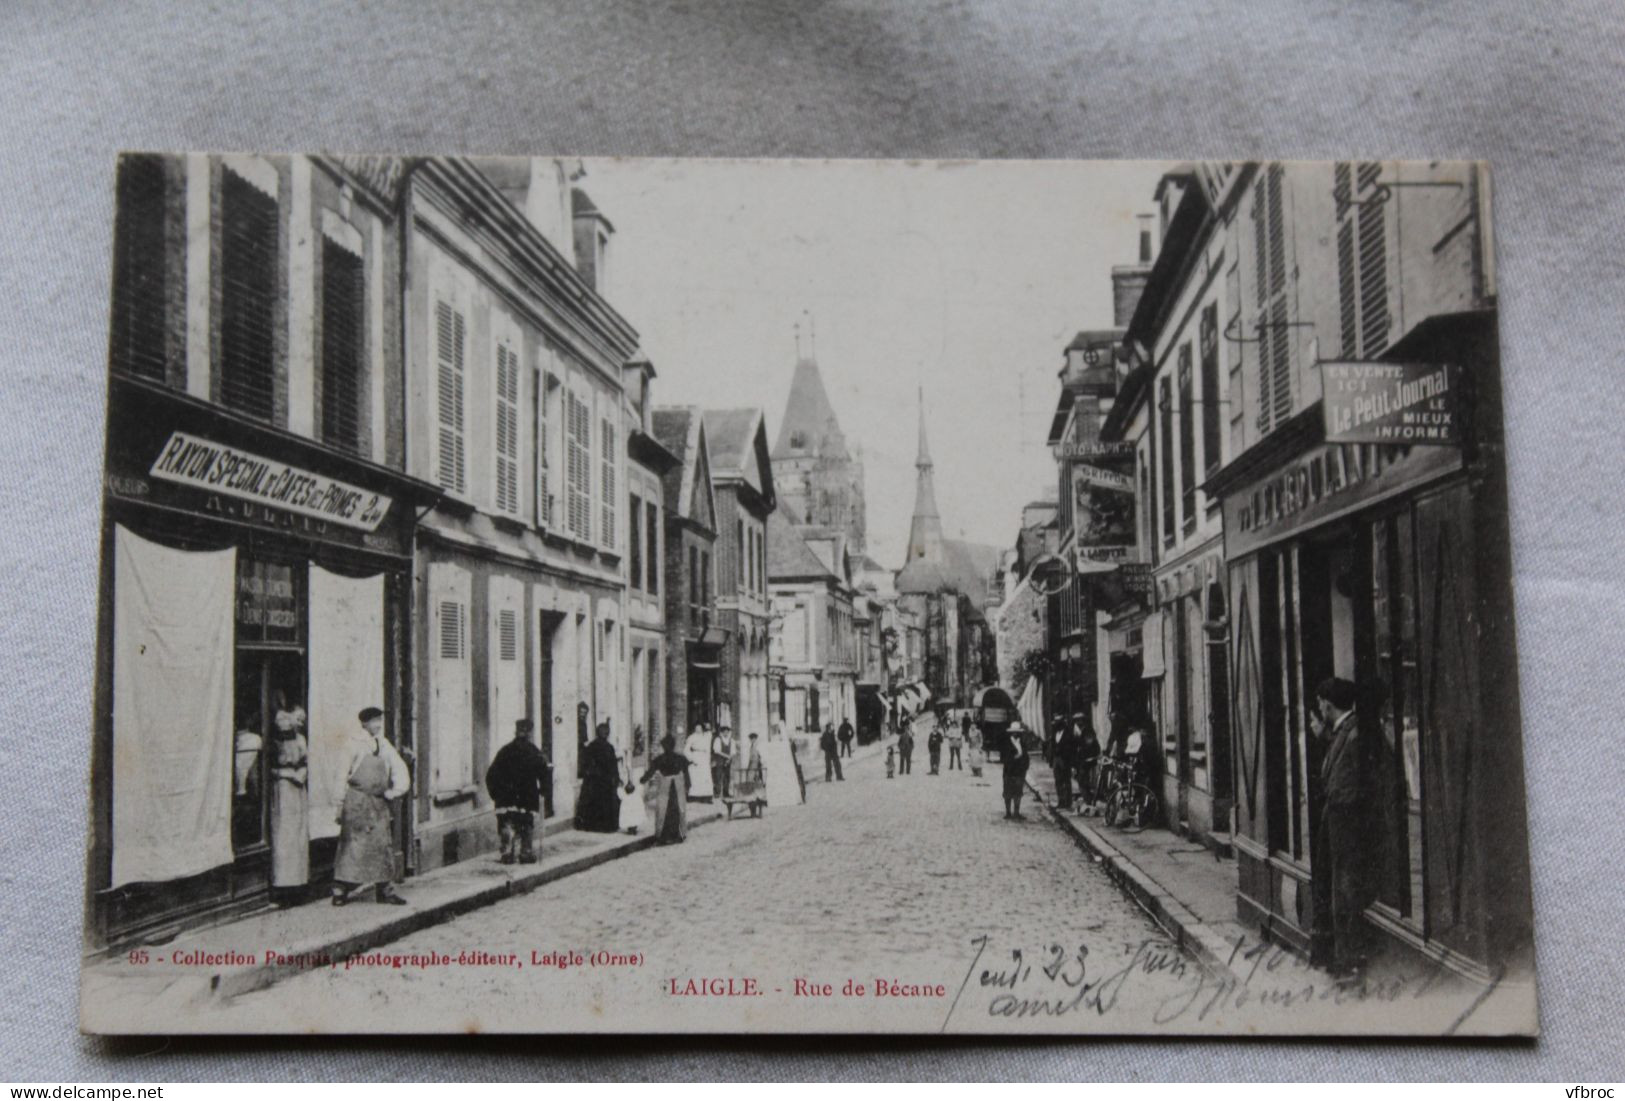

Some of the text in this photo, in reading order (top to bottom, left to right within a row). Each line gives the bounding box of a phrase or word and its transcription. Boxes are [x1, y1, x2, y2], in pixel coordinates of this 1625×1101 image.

[1329, 365, 1404, 379] EN VENTE
[1338, 380, 1368, 393] ICI
[1333, 364, 1449, 434] Le Petit Journal
[1429, 399, 1446, 411] LE
[1402, 412, 1452, 425] MIEUX
[157, 435, 220, 483] RAYON
[128, 951, 149, 965] 95
[172, 950, 256, 966] Collection
[345, 949, 523, 970] photographe-éditeur,
[531, 950, 583, 970] Laigle
[590, 950, 645, 968] (Orne)
[669, 978, 764, 996] LAIGLE.
[793, 978, 833, 997] Rue
[842, 978, 865, 997] de
[874, 976, 945, 997] Bécane
